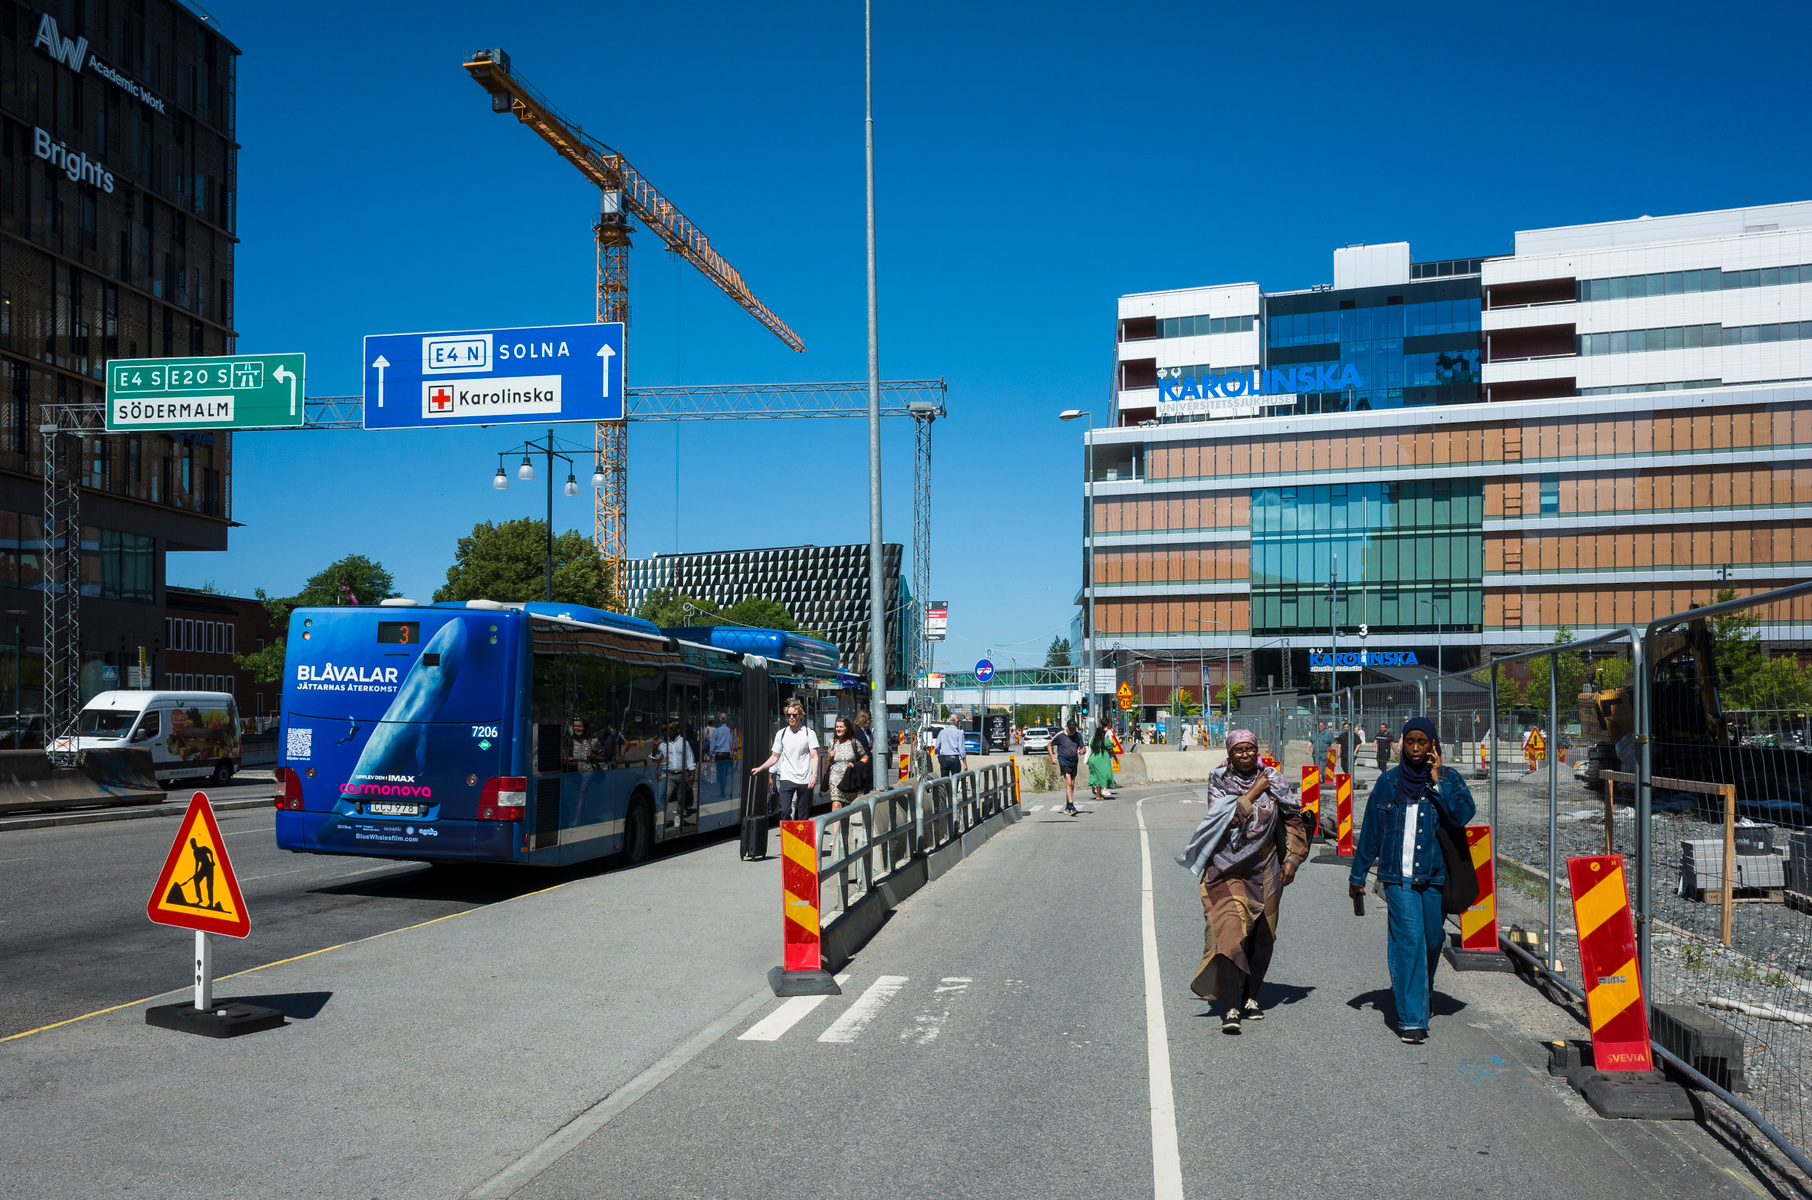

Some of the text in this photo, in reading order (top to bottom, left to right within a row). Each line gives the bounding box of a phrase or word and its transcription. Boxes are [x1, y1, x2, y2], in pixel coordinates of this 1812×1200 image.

[34, 13, 88, 73] AW
[88, 54, 165, 115] Academic Work
[34, 126, 115, 194] Brights
[436, 346, 479, 363] E4 N
[499, 341, 570, 360] SOLNA
[120, 371, 161, 387] E4 S
[171, 369, 228, 385] E20 S
[1158, 363, 1364, 403] KAROLINSKA
[459, 387, 554, 406] Karolinska
[1159, 394, 1297, 413] UNIVERSITETSSJUKHUSET
[118, 401, 229, 420] SÖDERMALM
[399, 625, 410, 644] 3
[1358, 623, 1369, 636] 3
[1309, 651, 1419, 667] KAROLINSKA
[297, 662, 399, 683] BLÅVALAR
[297, 682, 398, 693] JÄTTARNAS ÅTERKOMST
[471, 725, 498, 738] 7206
[388, 774, 415, 783] IMAX
[339, 782, 432, 798] cosmonova
[374, 801, 414, 813] CCJ 978
[355, 832, 419, 843] BlueWhalesfilm.com
[1607, 1053, 1646, 1063] SVEVIA
